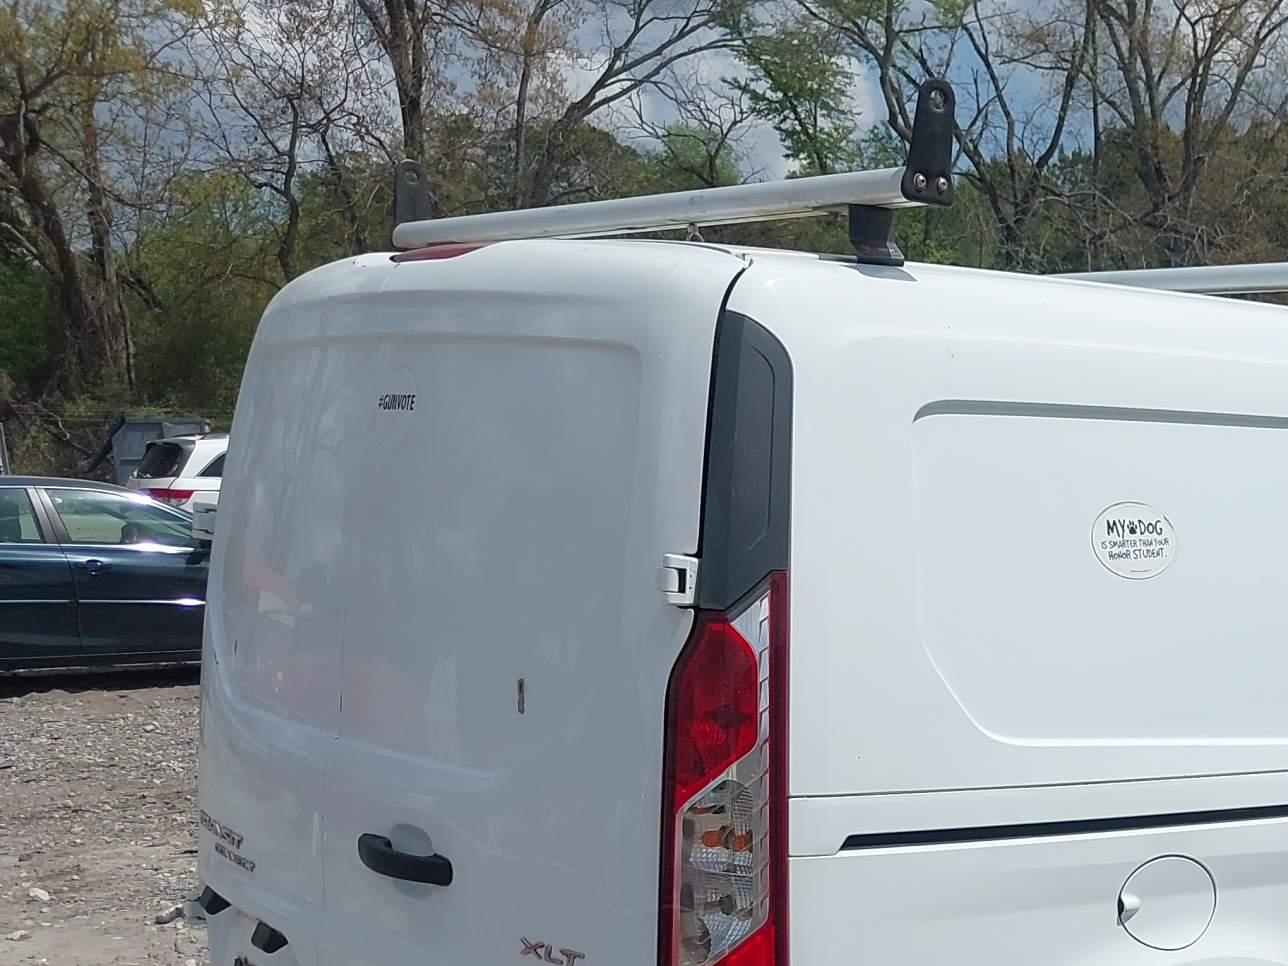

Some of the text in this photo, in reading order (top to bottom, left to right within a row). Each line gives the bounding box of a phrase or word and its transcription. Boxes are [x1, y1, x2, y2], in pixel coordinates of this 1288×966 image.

[379, 394, 416, 411] #GUNVOTE
[1106, 519, 1163, 539] MY DOG
[1108, 539, 1138, 549] SMARTER
[1153, 537, 1170, 547] YOUR
[1108, 550, 1131, 561] HONOR
